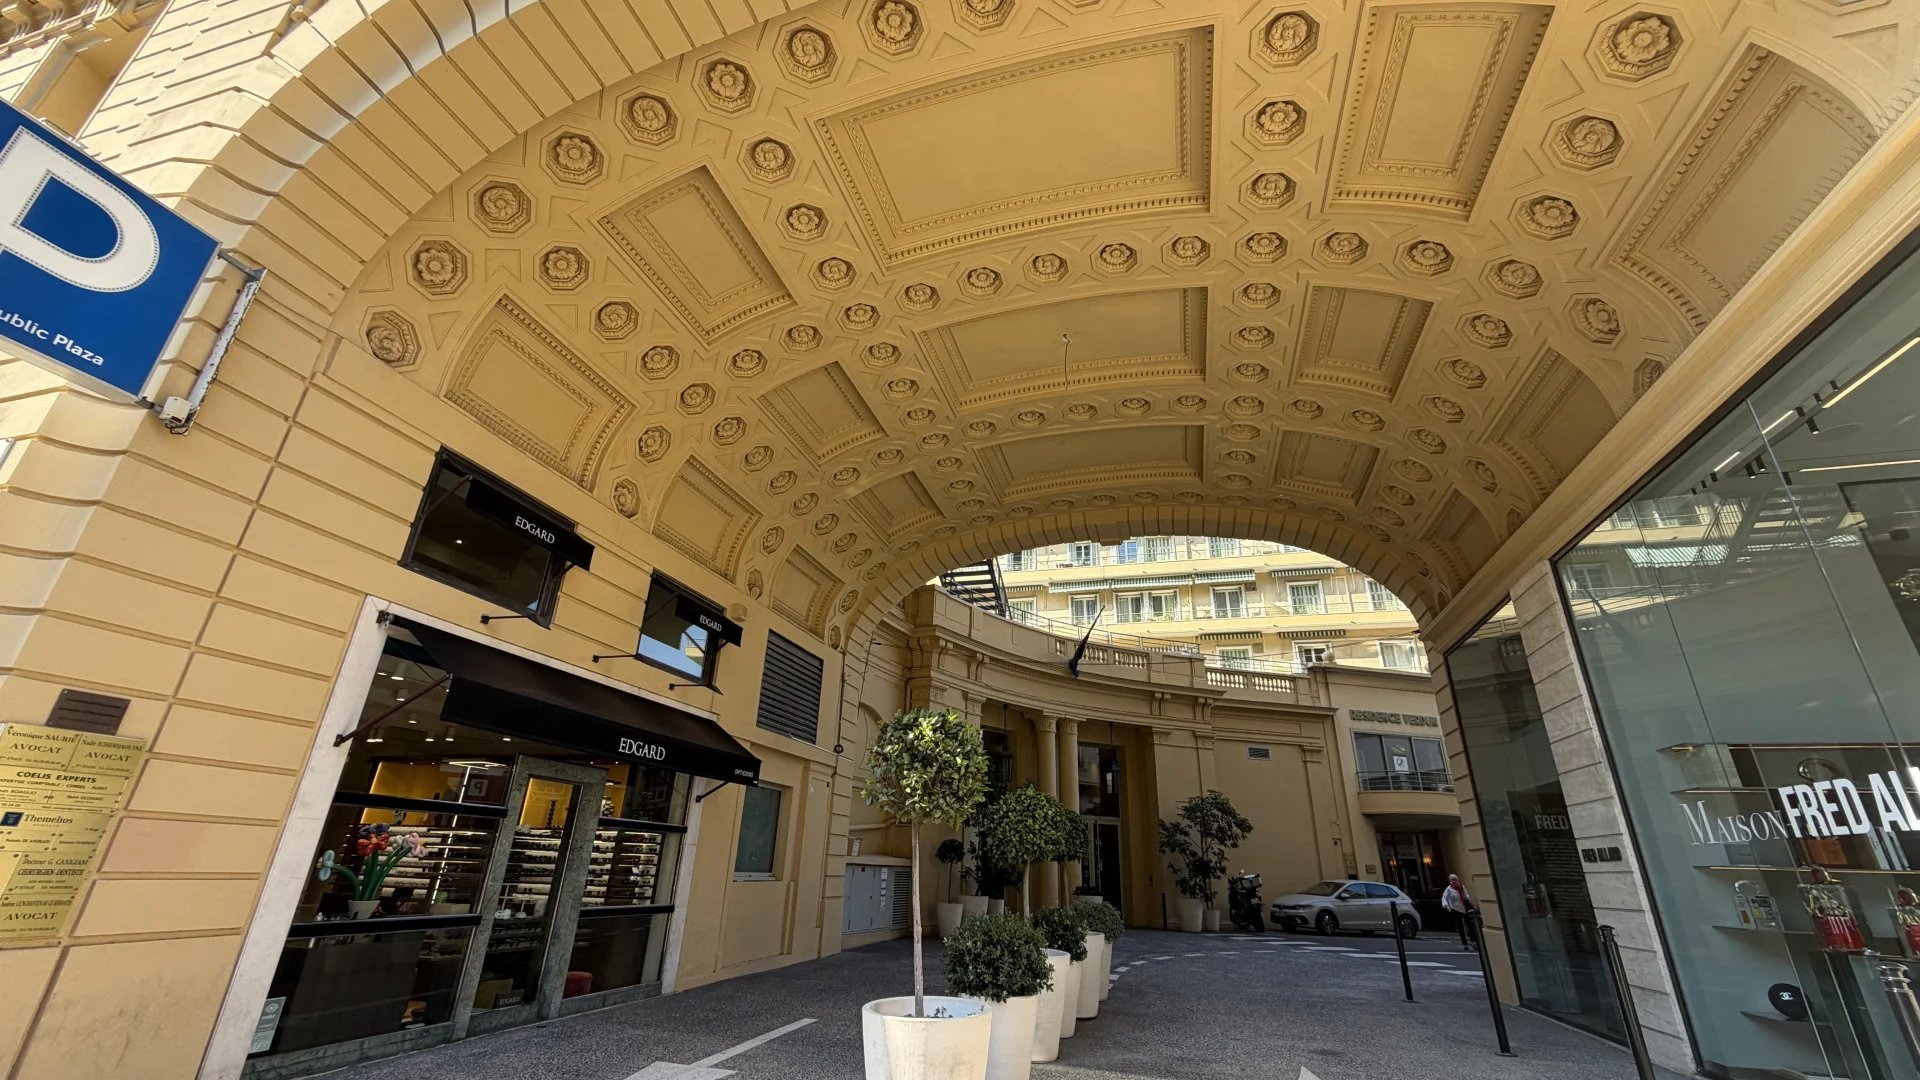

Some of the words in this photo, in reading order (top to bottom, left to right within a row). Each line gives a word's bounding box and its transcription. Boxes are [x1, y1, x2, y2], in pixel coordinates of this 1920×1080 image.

[0, 125, 160, 293] P
[52, 333, 104, 366] Plaza
[515, 515, 555, 543] EDGARD
[700, 614, 722, 631] EDGARD
[9, 743, 63, 754] AVOCAT
[618, 737, 666, 761] EDGARD
[84, 751, 132, 763] AVOCAT
[16, 771, 52, 780] COELIS
[56, 774, 97, 784] EXPERTS
[1778, 779, 1871, 838] FRED
[24, 814, 74, 824] Themelios
[1535, 815, 1570, 829] FRED
[4, 912, 58, 921] AVOCAT
